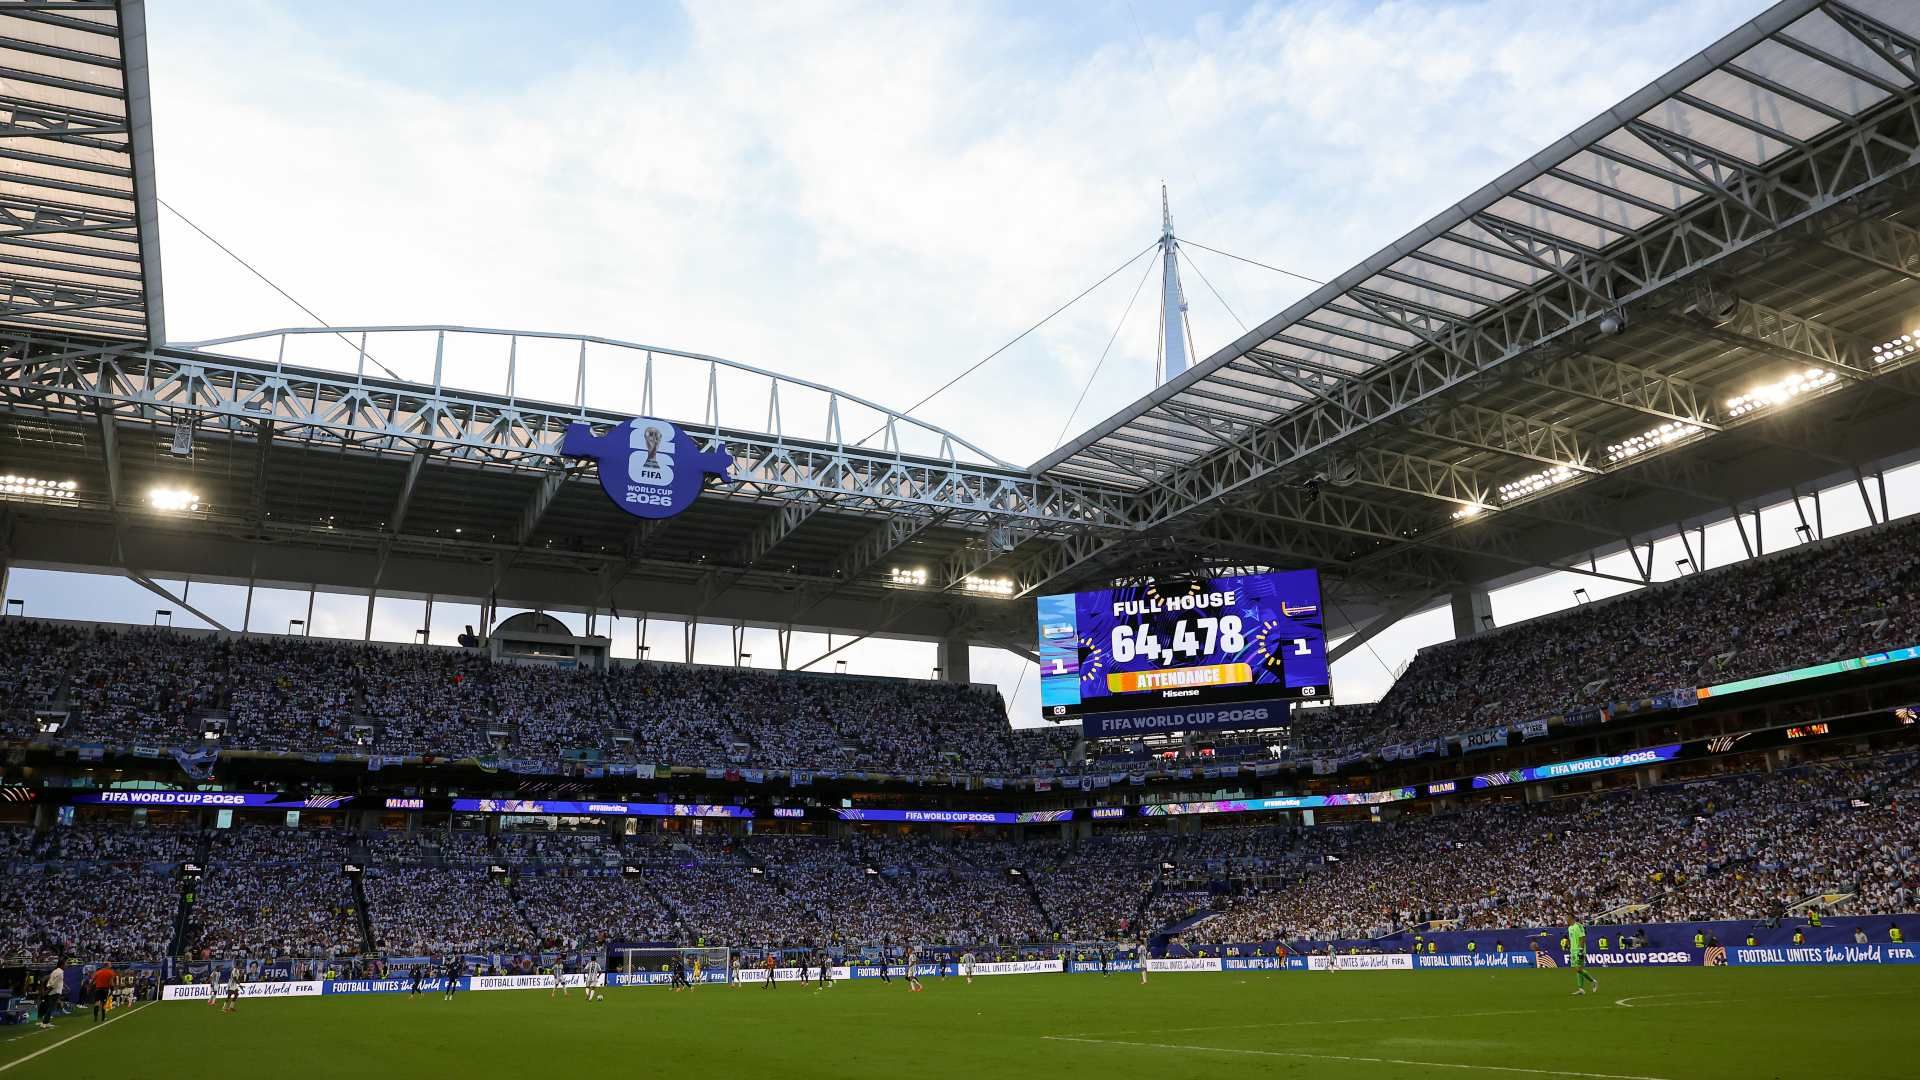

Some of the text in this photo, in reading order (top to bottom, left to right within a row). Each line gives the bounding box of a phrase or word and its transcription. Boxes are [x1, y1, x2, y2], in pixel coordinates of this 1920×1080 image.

[641, 470, 662, 479] FIFA
[628, 485, 656, 494] WORLD
[626, 492, 672, 506] 2026
[1113, 592, 1236, 617] FULL HOUSE
[1111, 615, 1244, 665] 64,478
[1294, 638, 1311, 655] 1
[1052, 658, 1068, 675] 1
[1136, 668, 1220, 688] ATTENDANCE
[1162, 689, 1199, 698] Hisense
[1102, 708, 1268, 731] FIFA WORLD CUP 2026
[1468, 731, 1498, 746] ROCK
[1550, 751, 1655, 775] FIFA WORLD CUP 2026
[1430, 782, 1454, 793] MIAMI
[102, 792, 244, 804] FIFA WORLD CUP 2026
[386, 798, 424, 808] MIAMI
[774, 808, 804, 817] MIAMI
[906, 812, 922, 820] FIFA
[923, 812, 952, 821] WORLD
[1093, 808, 1123, 818] MIAMI
[1586, 954, 1624, 964] WORLD
[1626, 953, 1647, 963] CUP
[1648, 952, 1688, 963] 2026
[1737, 945, 1914, 963] FOOTBALL UNITES the World FIFA
[1226, 960, 1247, 968] FOOTBALL
[1341, 958, 1357, 967] UNITES
[1360, 957, 1369, 967] the
[1370, 957, 1388, 968] World
[1420, 956, 1449, 966] FOOTBALL
[1450, 955, 1472, 966] UNITES
[1473, 954, 1485, 966] the
[1486, 953, 1508, 967] World
[918, 966, 936, 975] World
[1024, 962, 1042, 971] World
[1074, 962, 1098, 971] FOOTBALL
[264, 969, 288, 978] FIFA
[616, 974, 648, 984] FOOTBALL
[650, 974, 672, 983] UNITES
[332, 981, 370, 992] FOOTBALL
[372, 981, 398, 991] UNITES
[400, 980, 412, 990] the
[417, 979, 441, 990] World
[480, 978, 514, 988] FOOTBALL
[517, 978, 540, 987] UNITES
[248, 984, 262, 994] the
[264, 983, 290, 995] World
